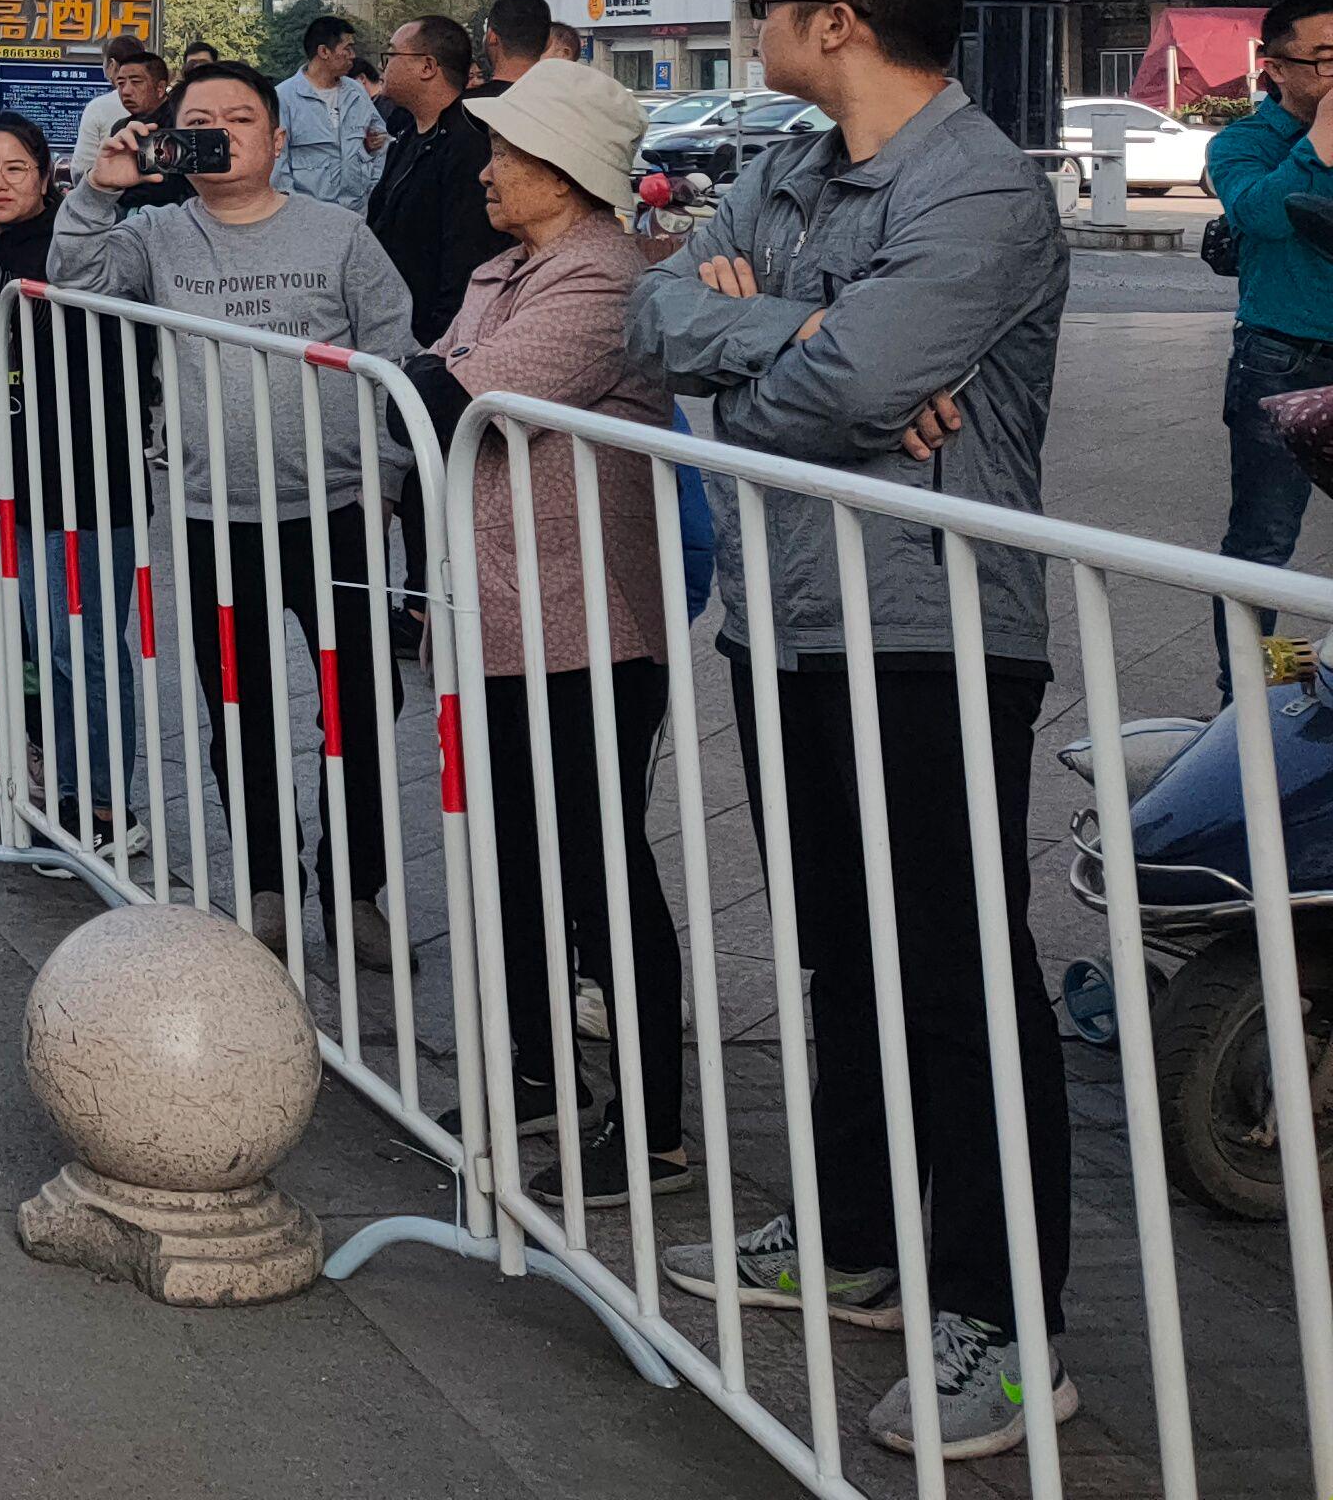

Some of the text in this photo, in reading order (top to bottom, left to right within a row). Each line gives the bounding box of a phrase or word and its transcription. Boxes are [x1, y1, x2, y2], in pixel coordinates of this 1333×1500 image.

[173, 273, 327, 295] OVER POWER YOUR
[225, 298, 271, 317] PARIS
[267, 321, 310, 337] YOUR
